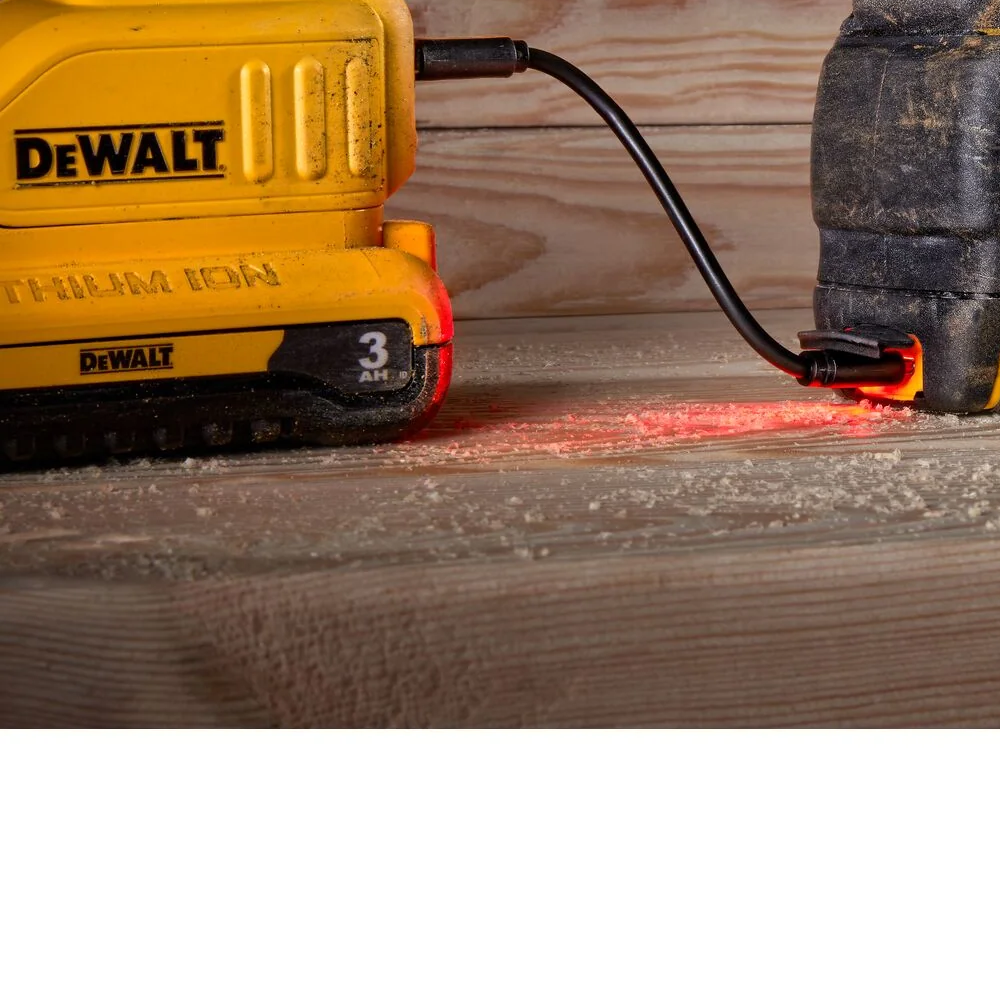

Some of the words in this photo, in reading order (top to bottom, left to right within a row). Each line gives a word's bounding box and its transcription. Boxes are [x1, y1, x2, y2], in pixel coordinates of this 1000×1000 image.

[184, 262, 281, 290] ION
[359, 331, 389, 370] 3
[359, 369, 388, 383] AH
